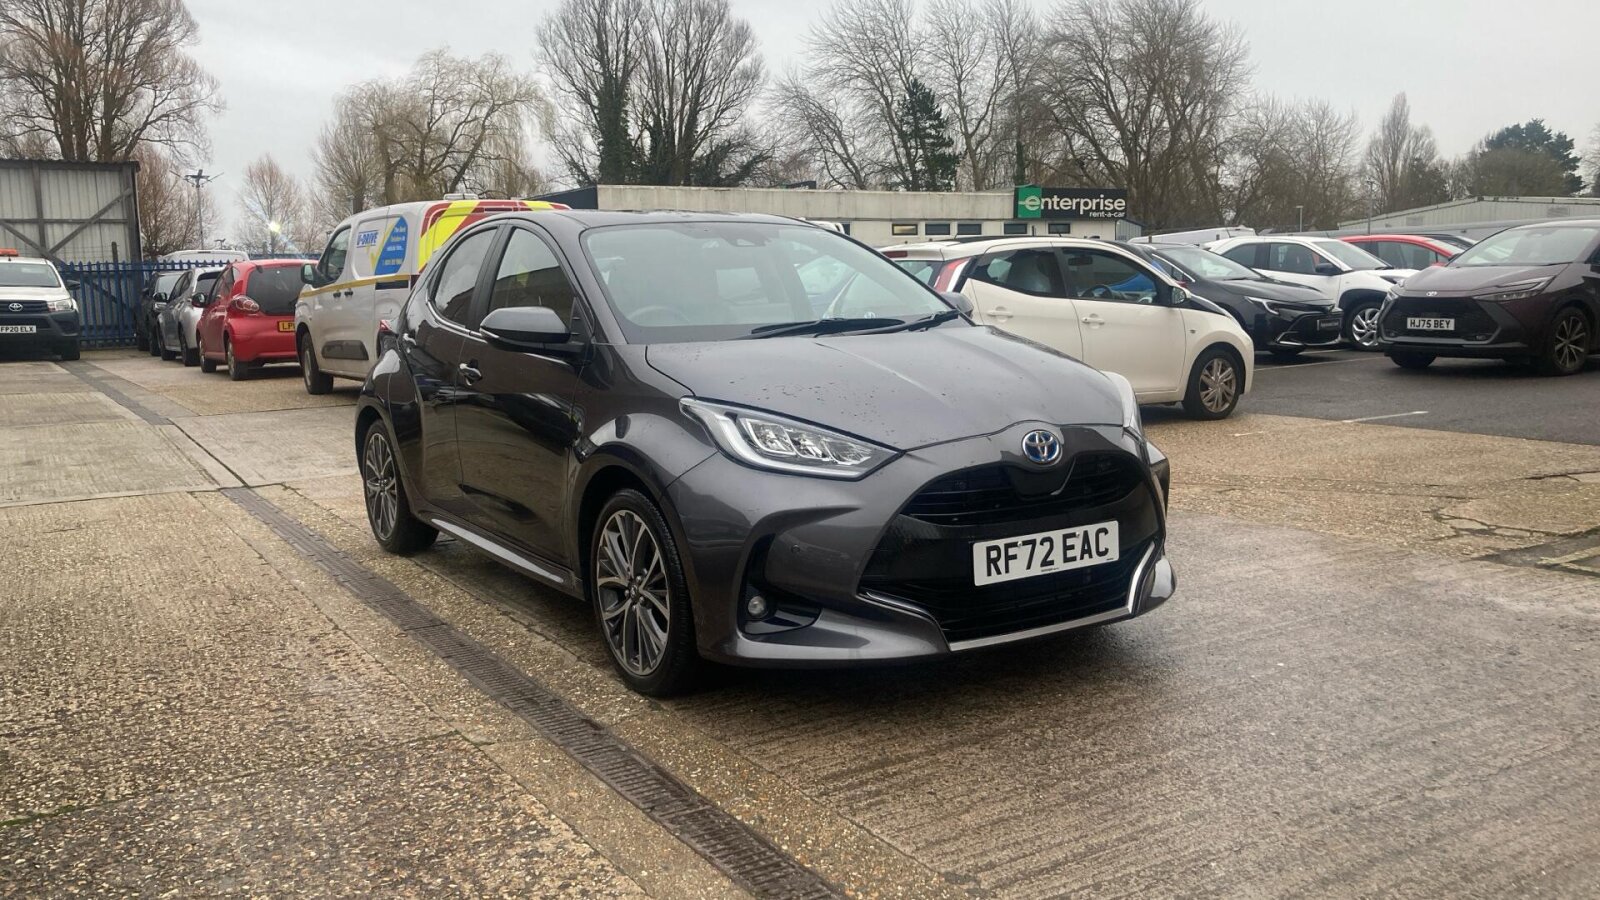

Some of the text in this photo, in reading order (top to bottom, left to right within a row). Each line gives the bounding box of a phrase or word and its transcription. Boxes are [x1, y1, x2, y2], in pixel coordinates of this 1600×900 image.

[1022, 194, 1126, 216] enterprise
[1089, 211, 1126, 219] rent-a-car
[356, 231, 379, 246] U-DRIVE
[1409, 319, 1452, 329] HJ75 BEY
[985, 526, 1110, 577] RF72 EAC
